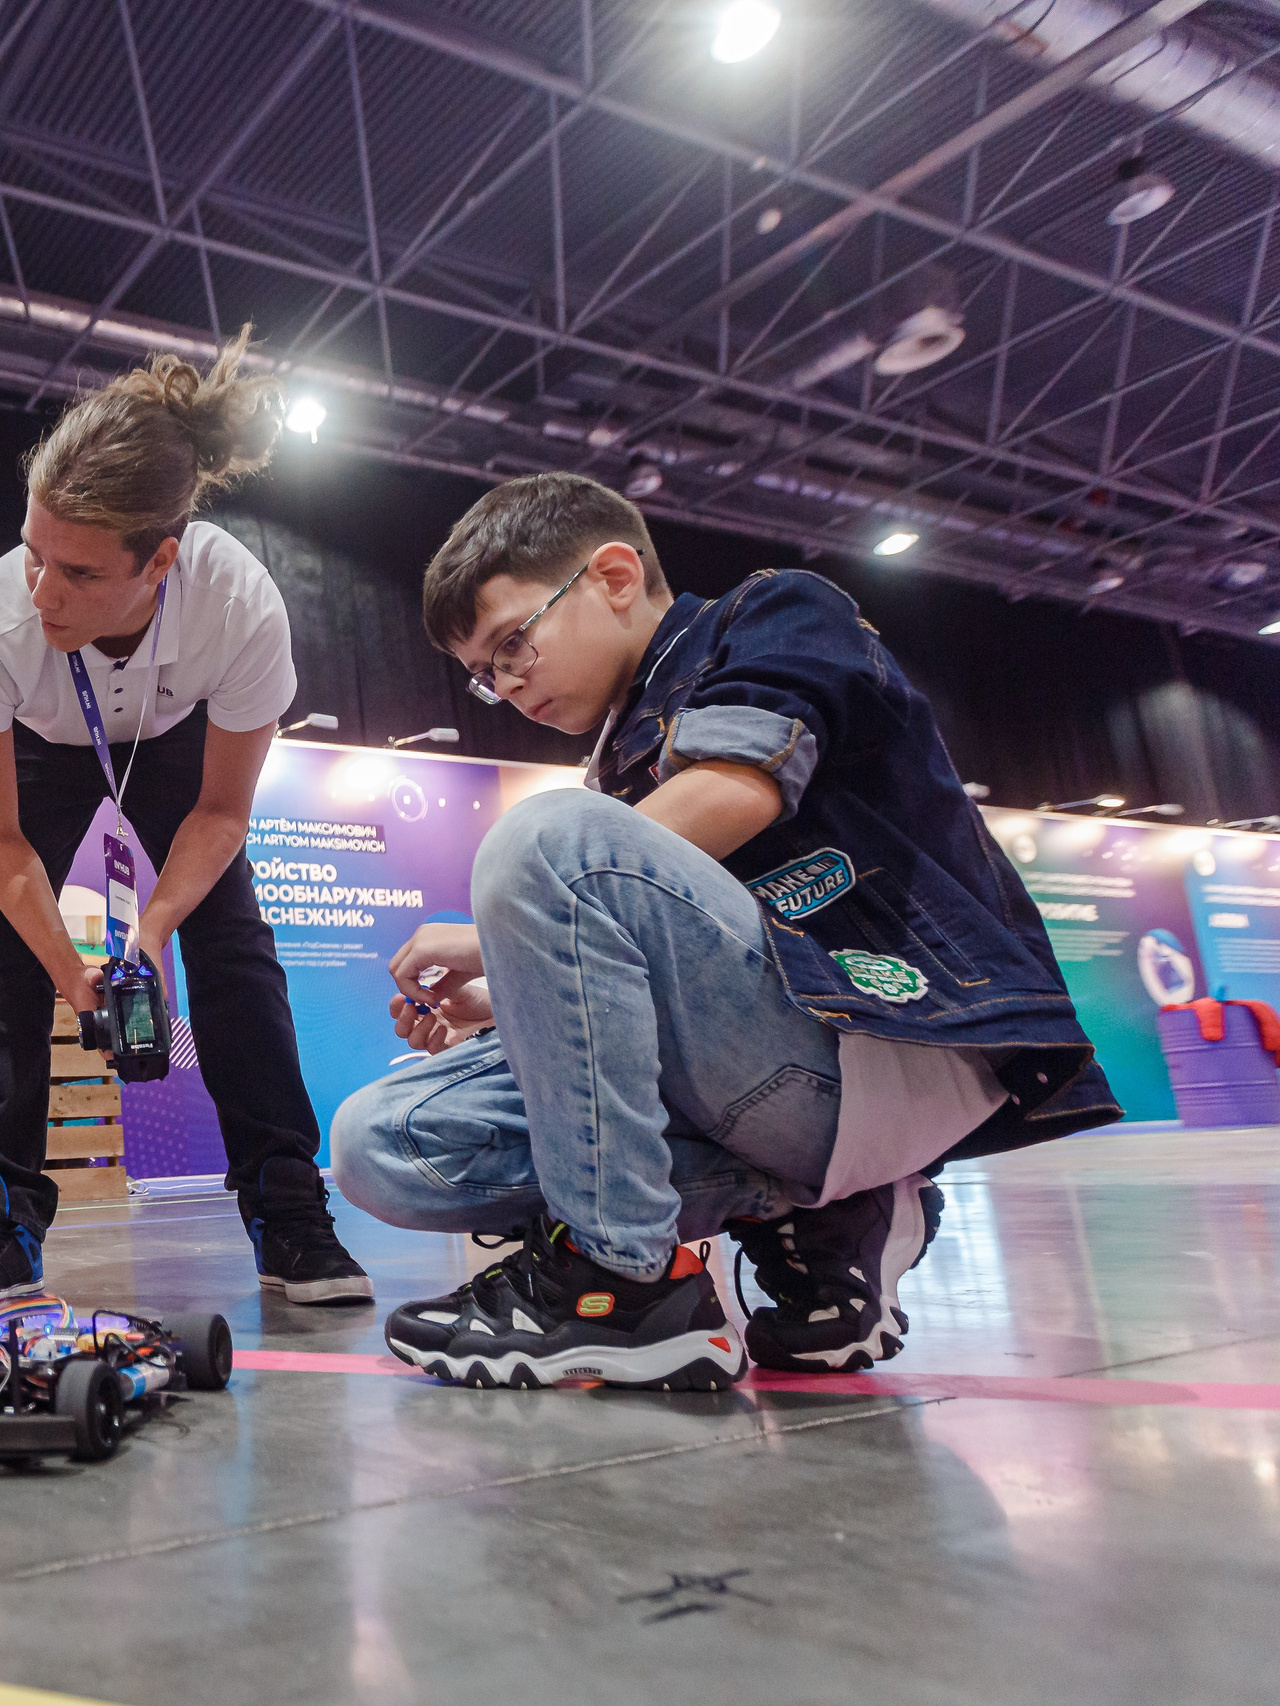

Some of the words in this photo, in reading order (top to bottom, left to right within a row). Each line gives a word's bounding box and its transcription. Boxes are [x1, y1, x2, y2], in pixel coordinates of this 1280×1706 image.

[258, 818, 297, 833] АРТЁМ
[298, 821, 377, 838] МАКСИМОВИЧ
[263, 833, 309, 849] ARTYOM
[310, 836, 386, 853] MAKSIMOVICH
[775, 869, 845, 913] FUTURE
